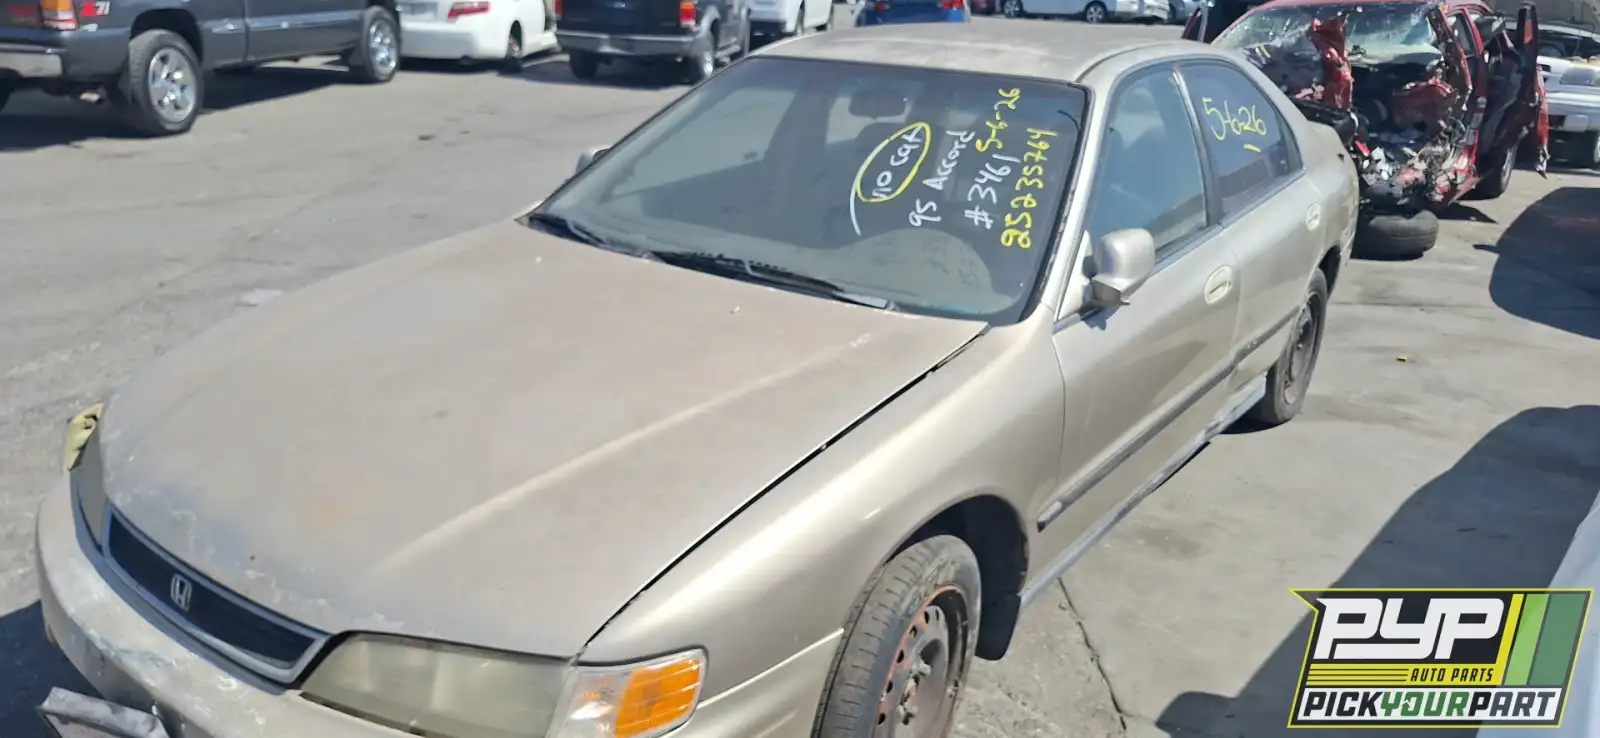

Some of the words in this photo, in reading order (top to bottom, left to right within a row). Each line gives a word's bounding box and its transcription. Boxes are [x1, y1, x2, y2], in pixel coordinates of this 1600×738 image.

[1202, 96, 1267, 141] 5-6-26
[922, 129, 976, 191] Accord
[964, 153, 1021, 229] #3461
[1001, 127, 1059, 249] 25235764
[908, 199, 941, 227] 95
